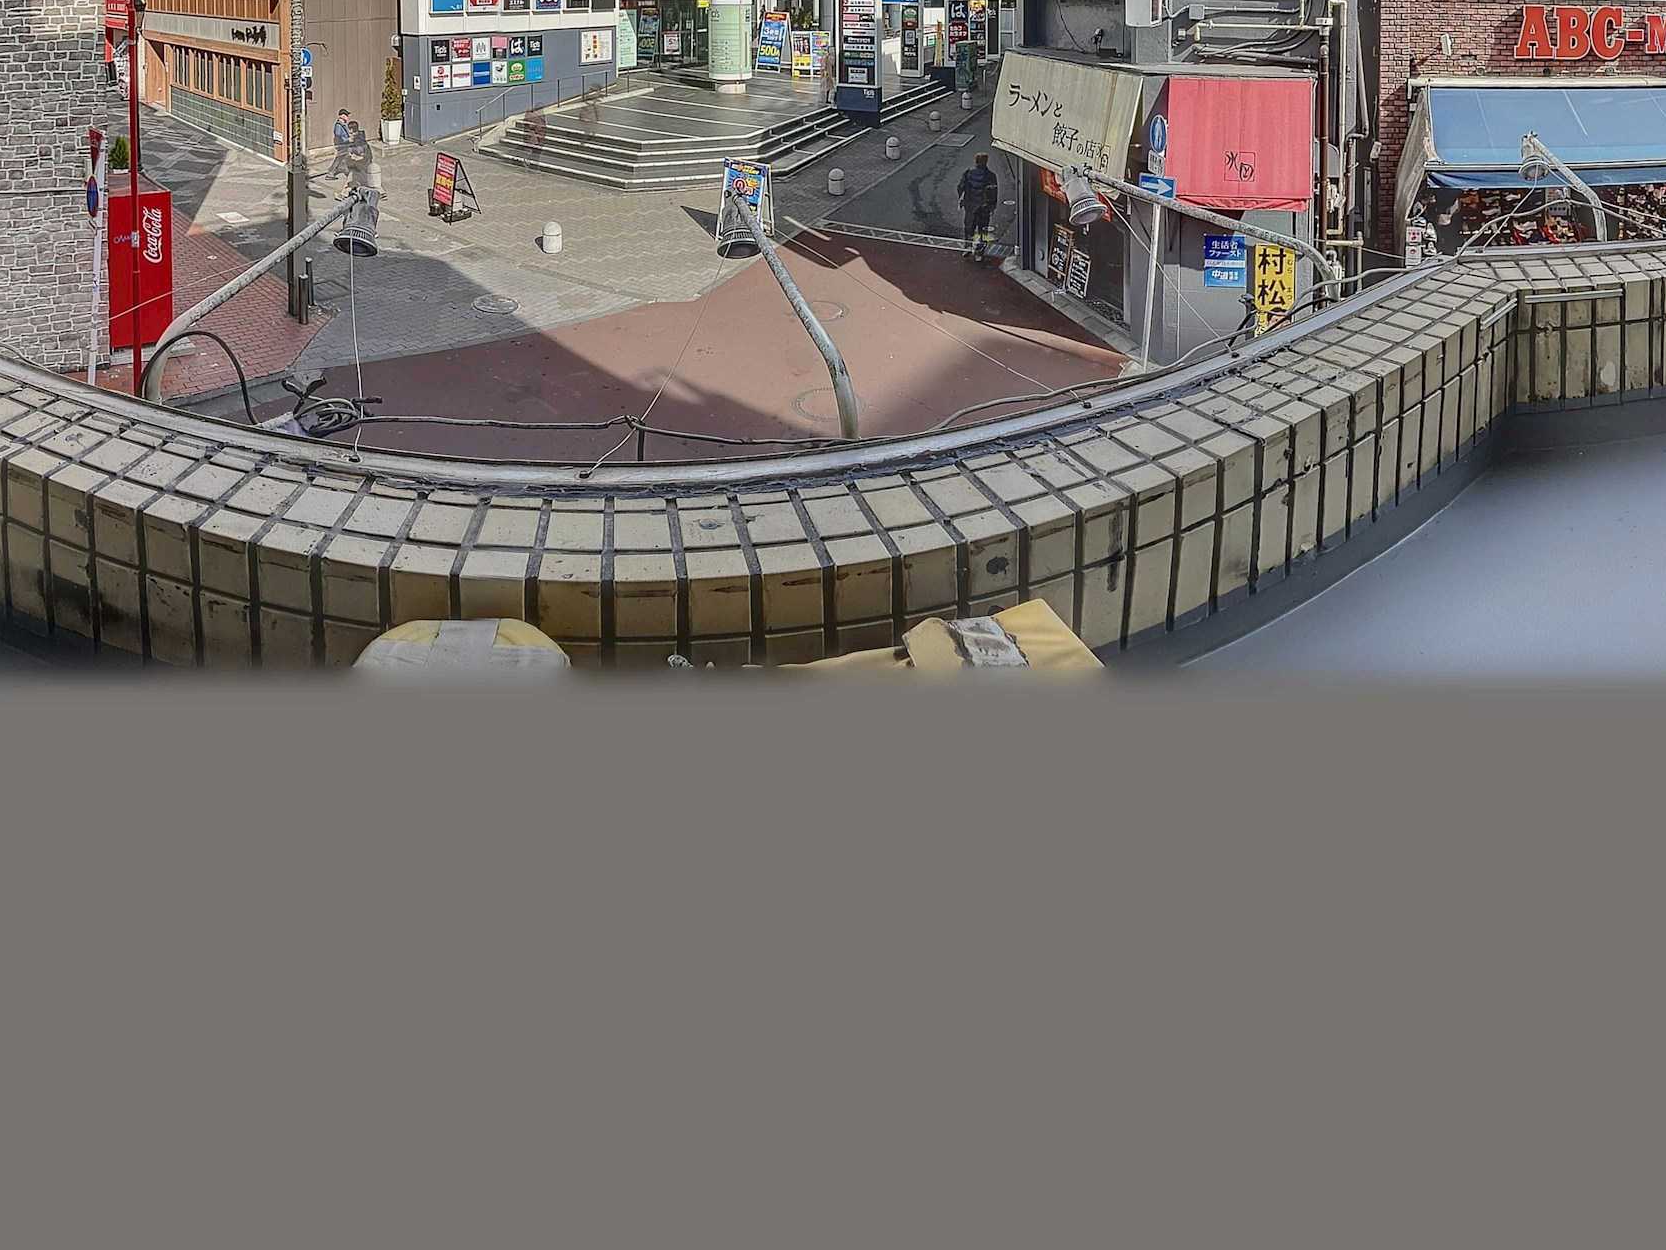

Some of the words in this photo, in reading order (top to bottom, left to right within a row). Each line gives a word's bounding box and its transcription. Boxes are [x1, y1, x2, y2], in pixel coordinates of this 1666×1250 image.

[951, 2, 966, 18] は
[511, 38, 524, 54] は
[1009, 83, 1063, 119] ラーメンと
[1052, 122, 1097, 159] 餃子の店
[142, 206, 163, 264] Coca-Cola
[1258, 248, 1287, 306] 村松
